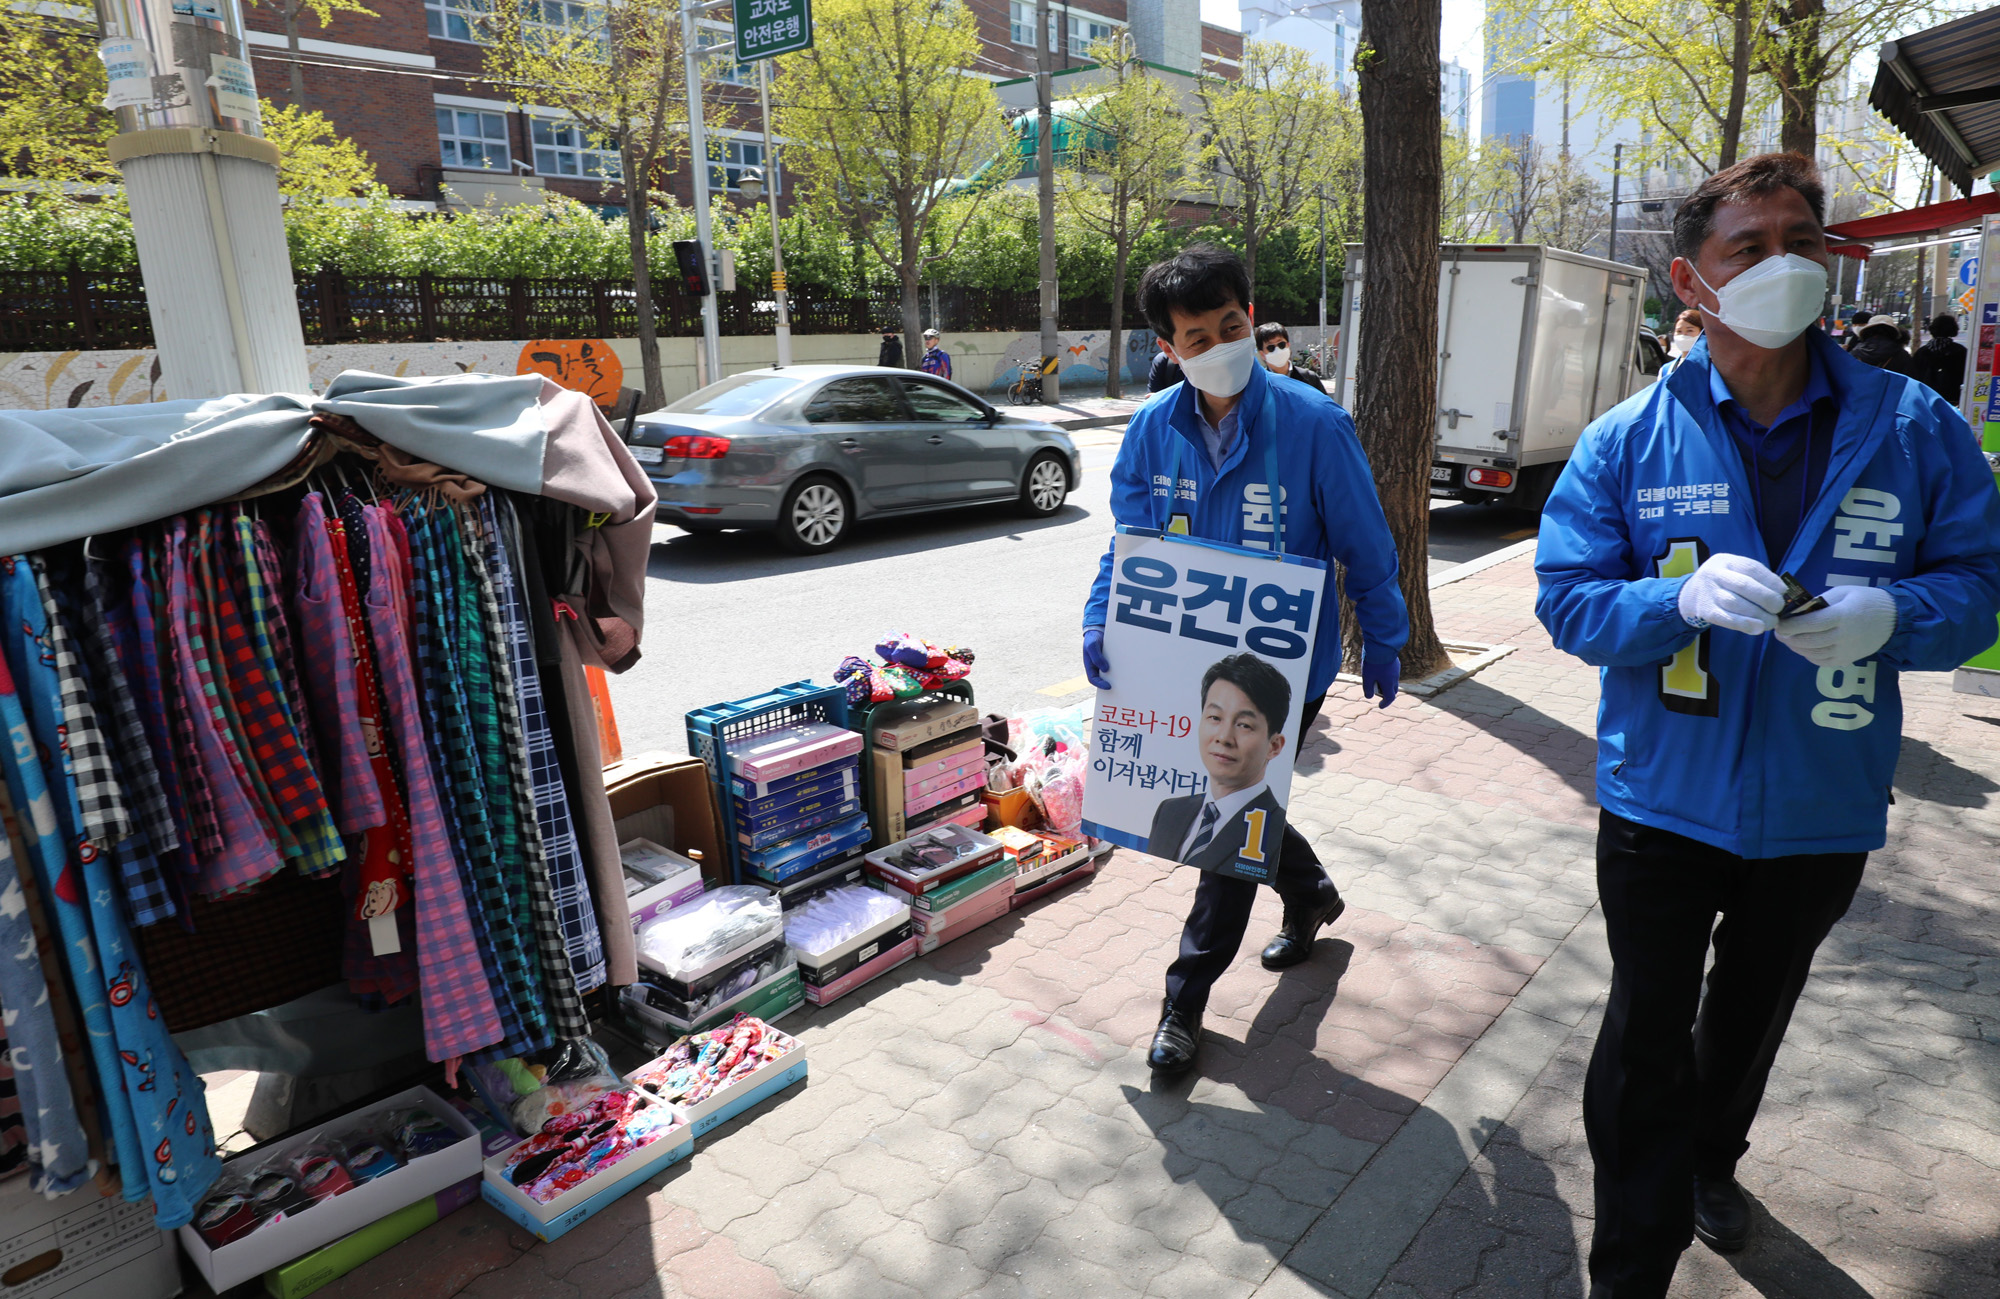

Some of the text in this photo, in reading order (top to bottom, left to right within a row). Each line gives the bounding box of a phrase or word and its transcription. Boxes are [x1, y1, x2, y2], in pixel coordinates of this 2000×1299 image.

[743, 14, 801, 49] 안전운행
[530, 342, 608, 399] 가을
[1637, 483, 1730, 503] 더불어민주당
[1639, 499, 1730, 520] 21대 구로을
[1115, 556, 1315, 660] 윤건영
[1811, 487, 1904, 731] 윤영
[1098, 704, 1192, 738] 코로나-19
[1097, 728, 1143, 759] 함께
[1093, 756, 1208, 797] 이겨냅시다!
[1239, 808, 1268, 863] 1
